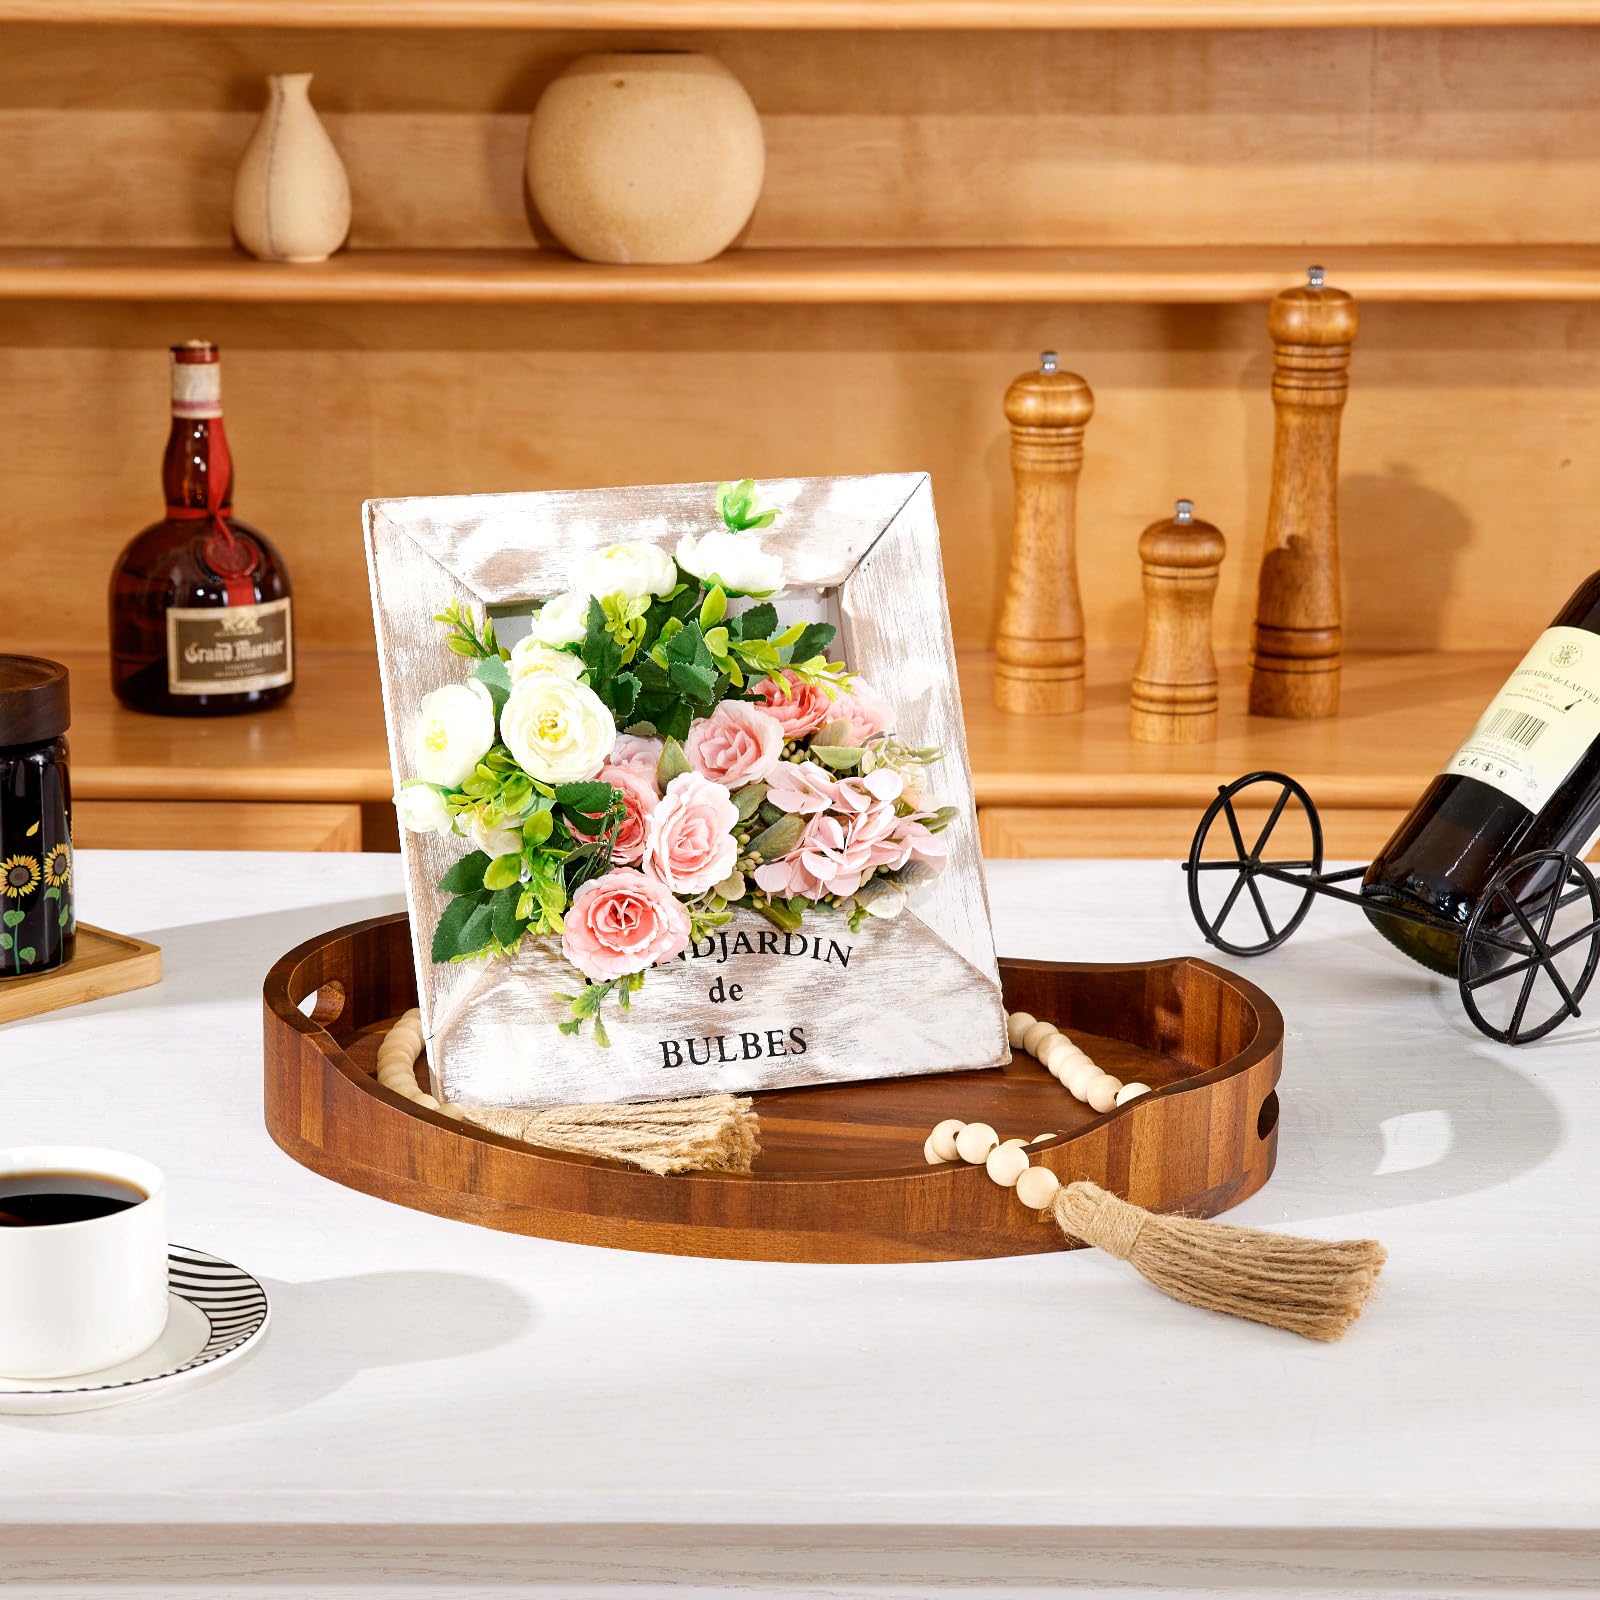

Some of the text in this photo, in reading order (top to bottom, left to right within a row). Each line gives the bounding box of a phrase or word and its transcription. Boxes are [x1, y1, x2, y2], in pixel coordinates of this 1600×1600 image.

[184, 639, 284, 663] Grand Marnier
[708, 976, 744, 1004] de
[658, 1026, 808, 1069] BULBES
